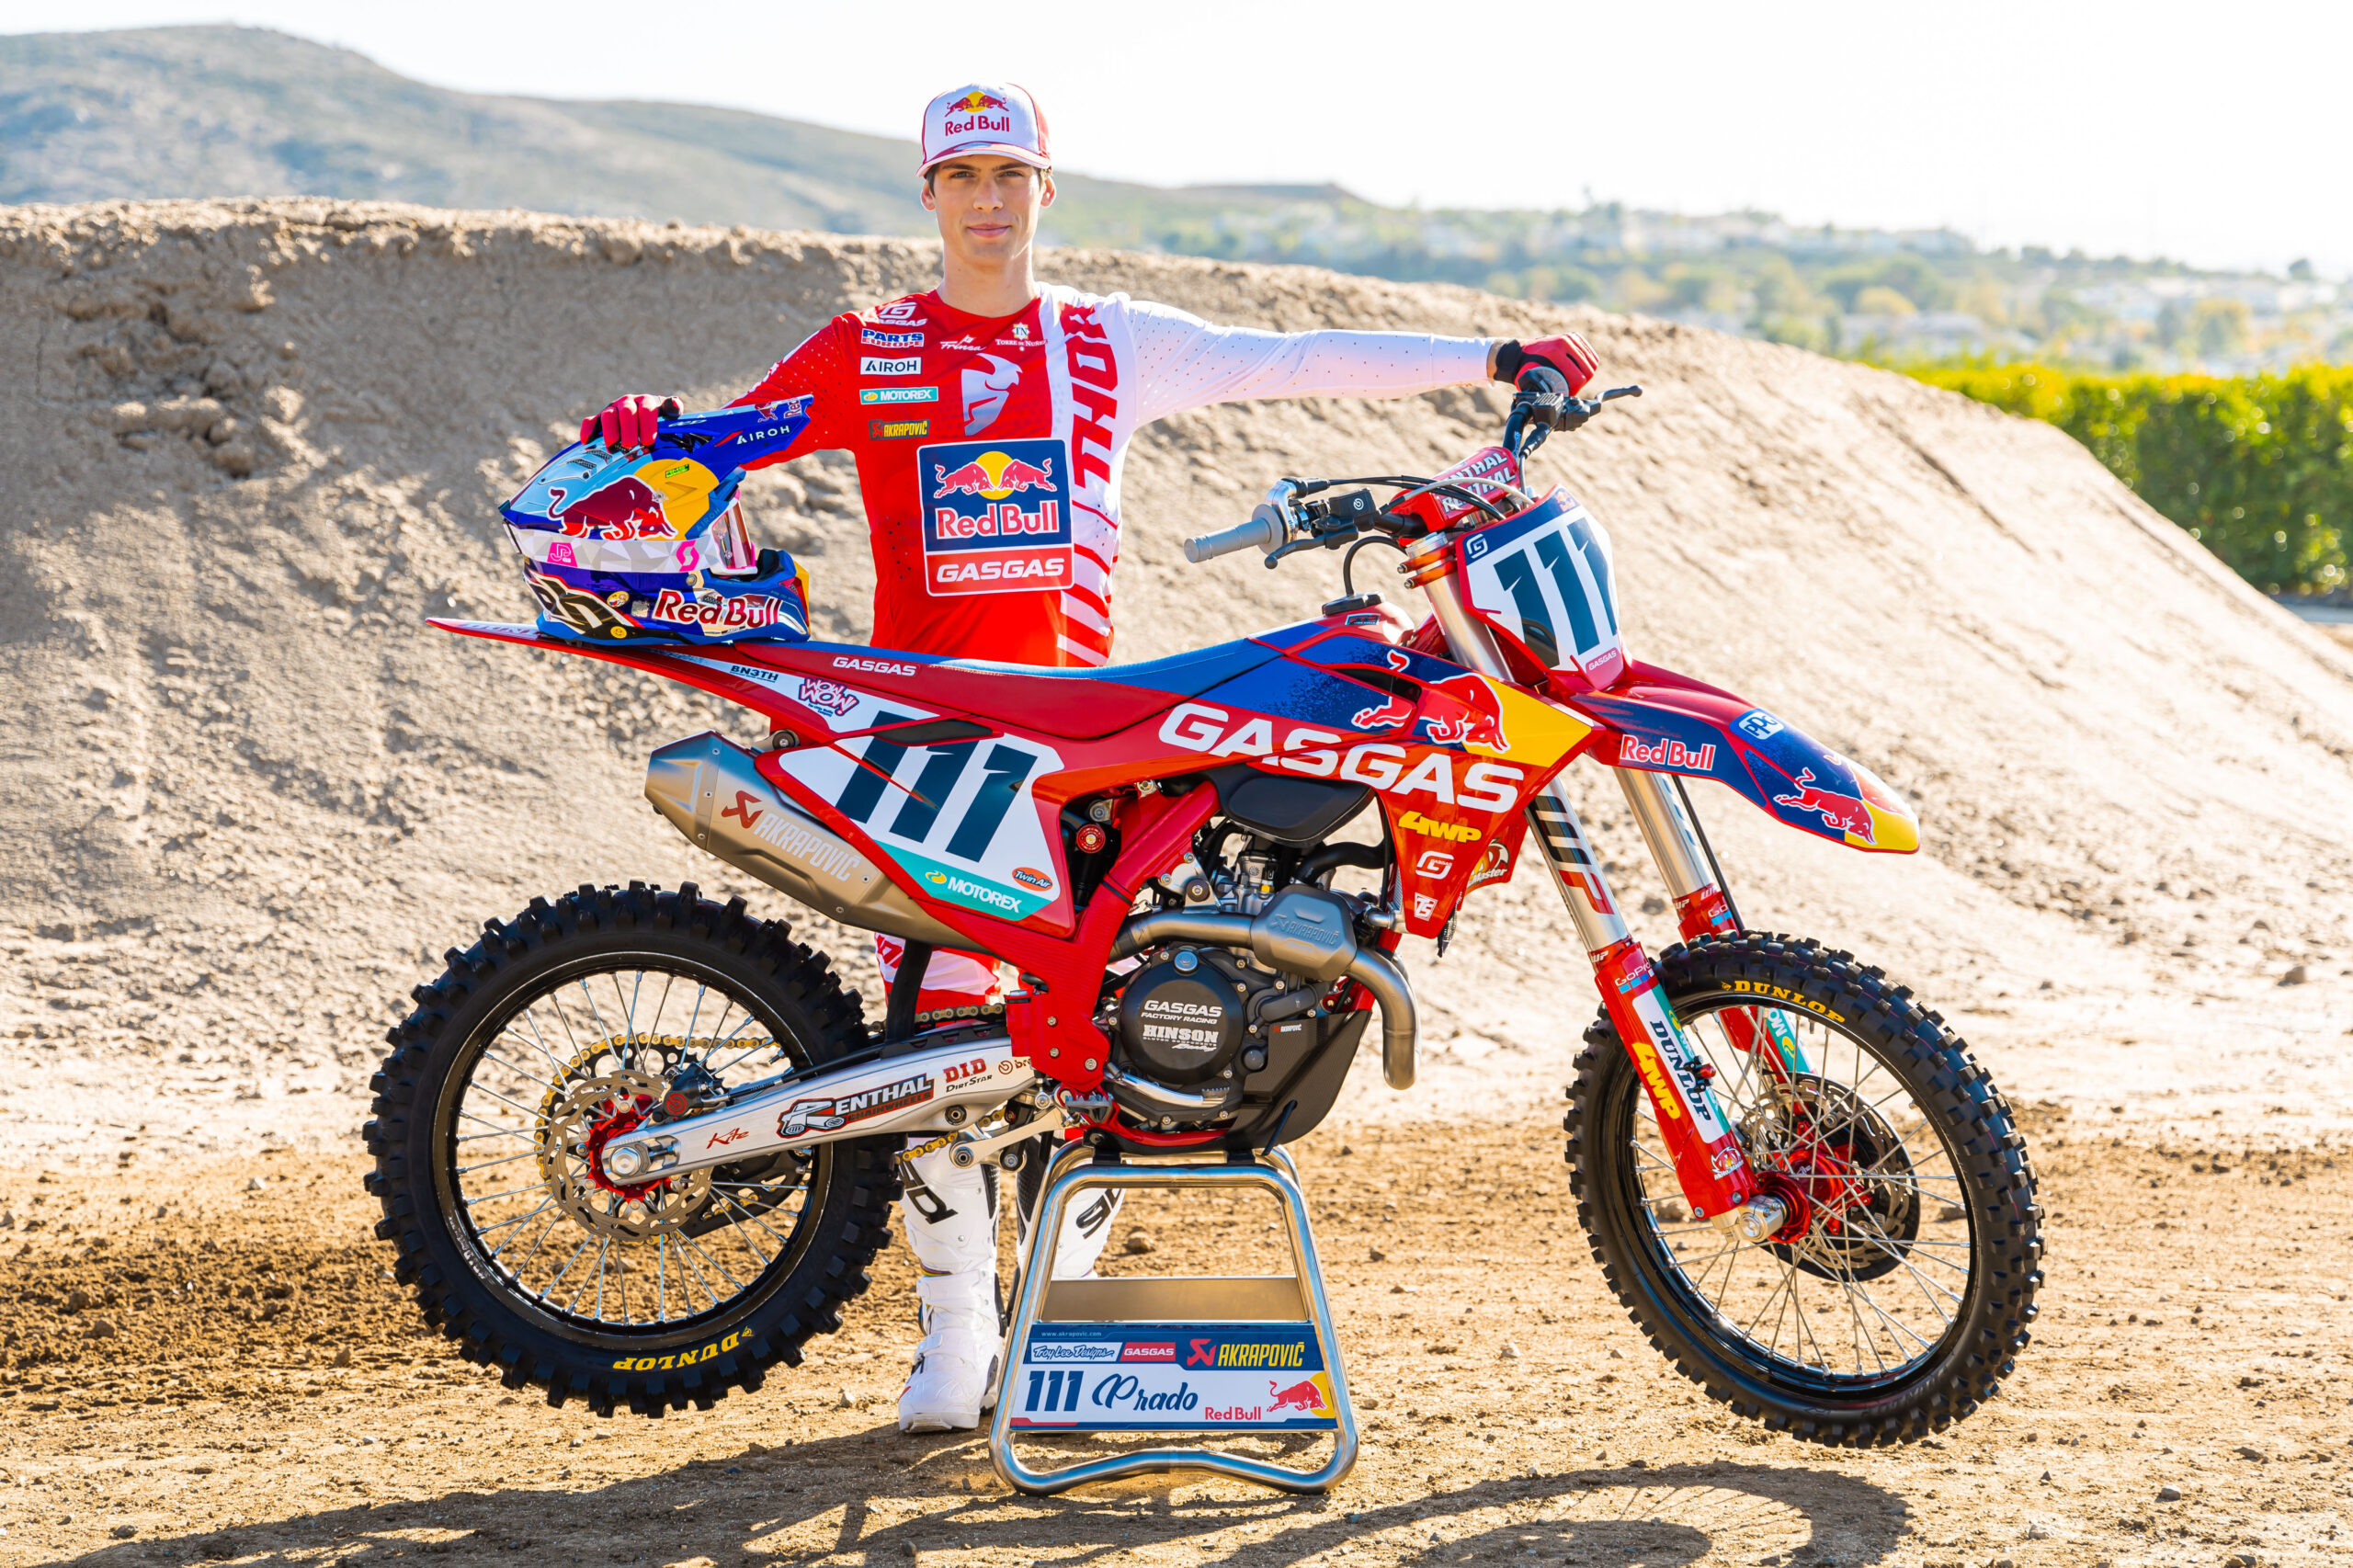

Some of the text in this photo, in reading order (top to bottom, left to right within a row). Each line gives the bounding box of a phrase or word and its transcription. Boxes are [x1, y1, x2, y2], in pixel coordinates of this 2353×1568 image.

[945, 115, 1010, 136] Red Bull
[861, 336, 924, 348] EUROPE
[862, 328, 924, 343] PARTS
[865, 360, 917, 372] AIROH
[881, 390, 932, 401] MOTOREX
[736, 425, 791, 445] AIROH
[935, 499, 1060, 540] Red Bull
[937, 557, 1065, 583] GASGAS
[1494, 517, 1617, 669] 111
[652, 587, 723, 625] Red
[722, 595, 782, 629] Bull
[833, 656, 917, 676] GASGAS
[1588, 649, 1617, 672] GASGAS
[731, 665, 779, 682] BN3TH
[1744, 715, 1779, 737] PPG
[1158, 702, 1524, 813] GASGAS
[1620, 733, 1716, 771] Red Bull
[835, 710, 1038, 862] 111
[1398, 811, 1483, 844] 4WP
[753, 812, 866, 882] AKRAPOVIČ
[1015, 869, 1052, 889] Twin Air
[948, 876, 1023, 914] MOTOREX
[1143, 999, 1222, 1017] GASGAS
[1733, 980, 1846, 1023] DUNLOP
[1141, 1012, 1218, 1025] FACTORY RACING
[1142, 1024, 1220, 1043] HINSON
[779, 1077, 933, 1136] RENTHAL
[612, 1331, 740, 1371] DUNLOP
[1033, 1344, 1115, 1360] Troy Lee Designs
[1124, 1347, 1175, 1357] GASGAS
[1217, 1341, 1305, 1368] AKRAPOVIČ
[1025, 1370, 1085, 1412] 111
[1092, 1373, 1199, 1412] Prado
[1205, 1407, 1262, 1421] Red Bull
